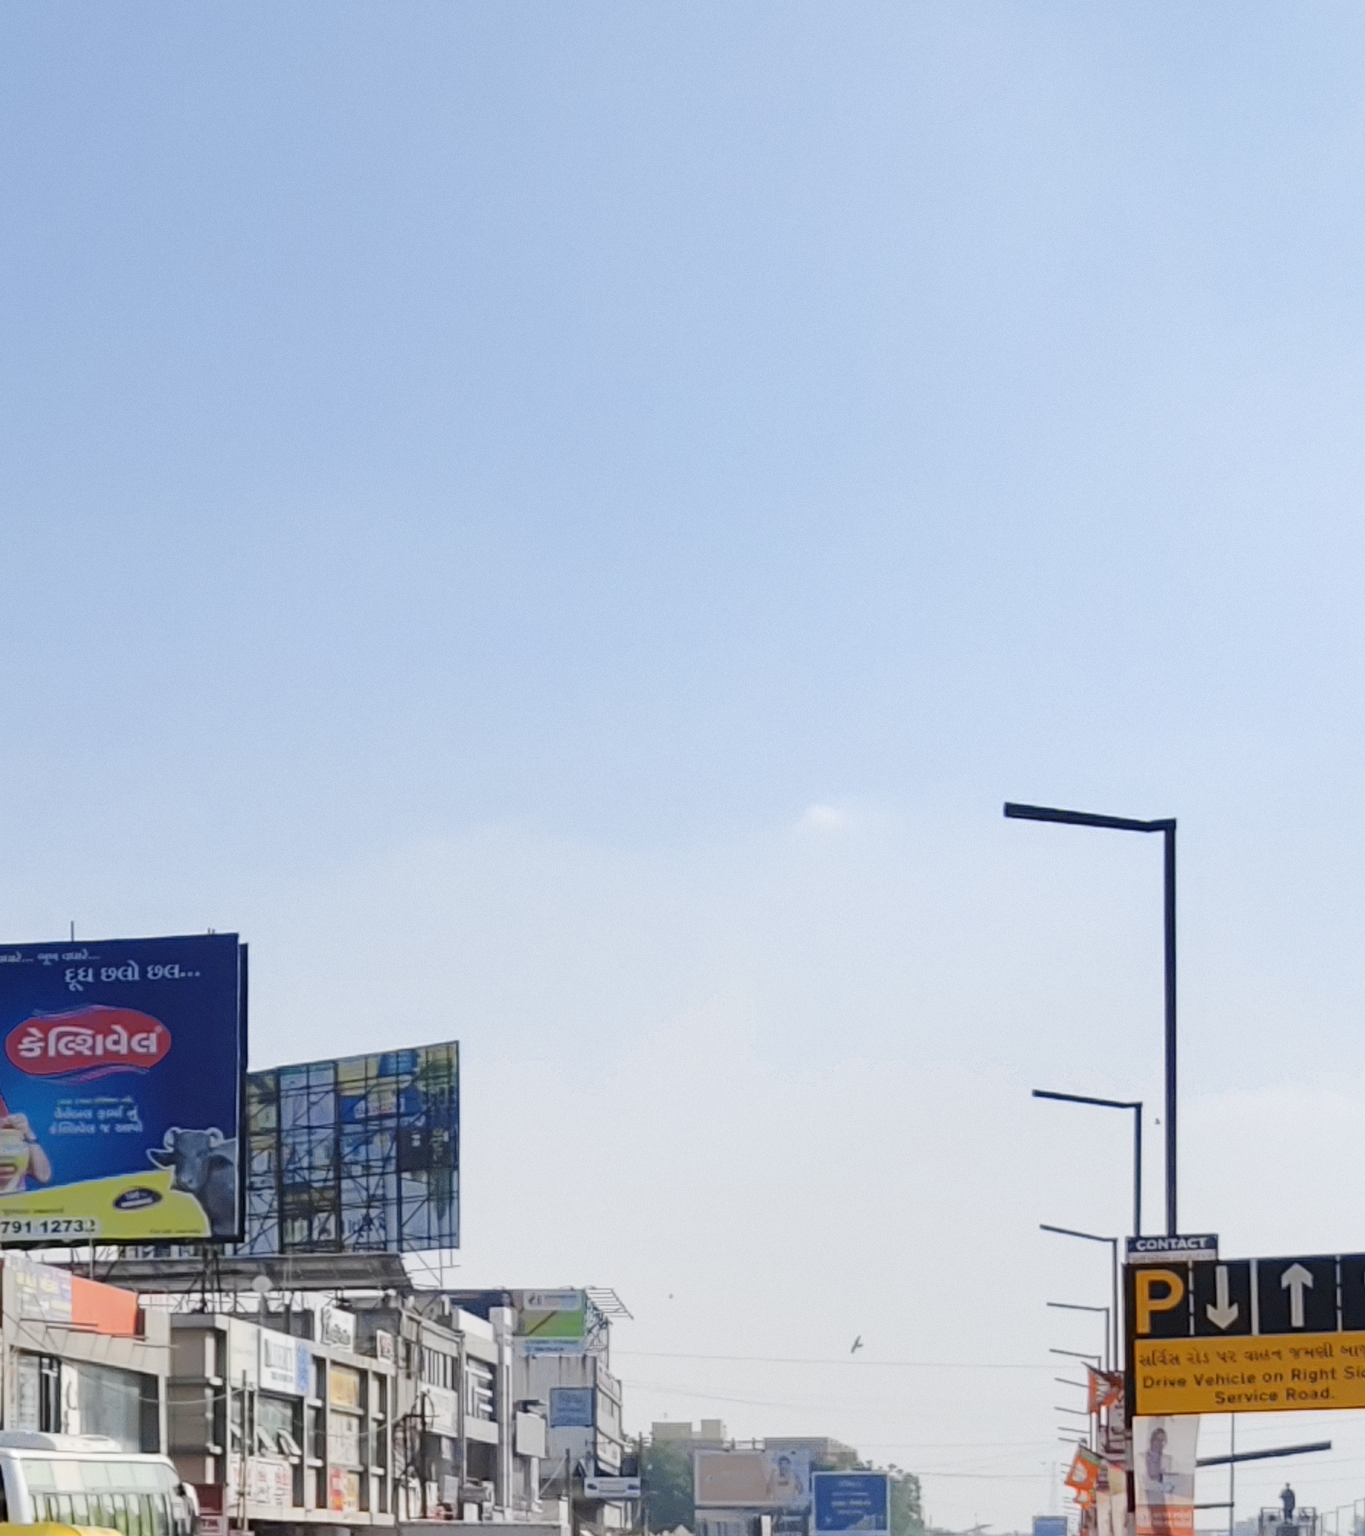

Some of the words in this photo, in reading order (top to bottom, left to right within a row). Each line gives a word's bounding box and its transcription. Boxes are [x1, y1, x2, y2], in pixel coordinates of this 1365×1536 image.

[65, 966, 94, 991] દૂધ
[1136, 1237, 1208, 1250] CONTACT
[1135, 1269, 1184, 1337] P
[1142, 1375, 1187, 1389] Drive
[1193, 1369, 1256, 1386] Vehicle
[1263, 1372, 1284, 1382] on
[1291, 1367, 1337, 1384] Right
[1215, 1390, 1278, 1405] Service
[1286, 1387, 1335, 1401] Road.
